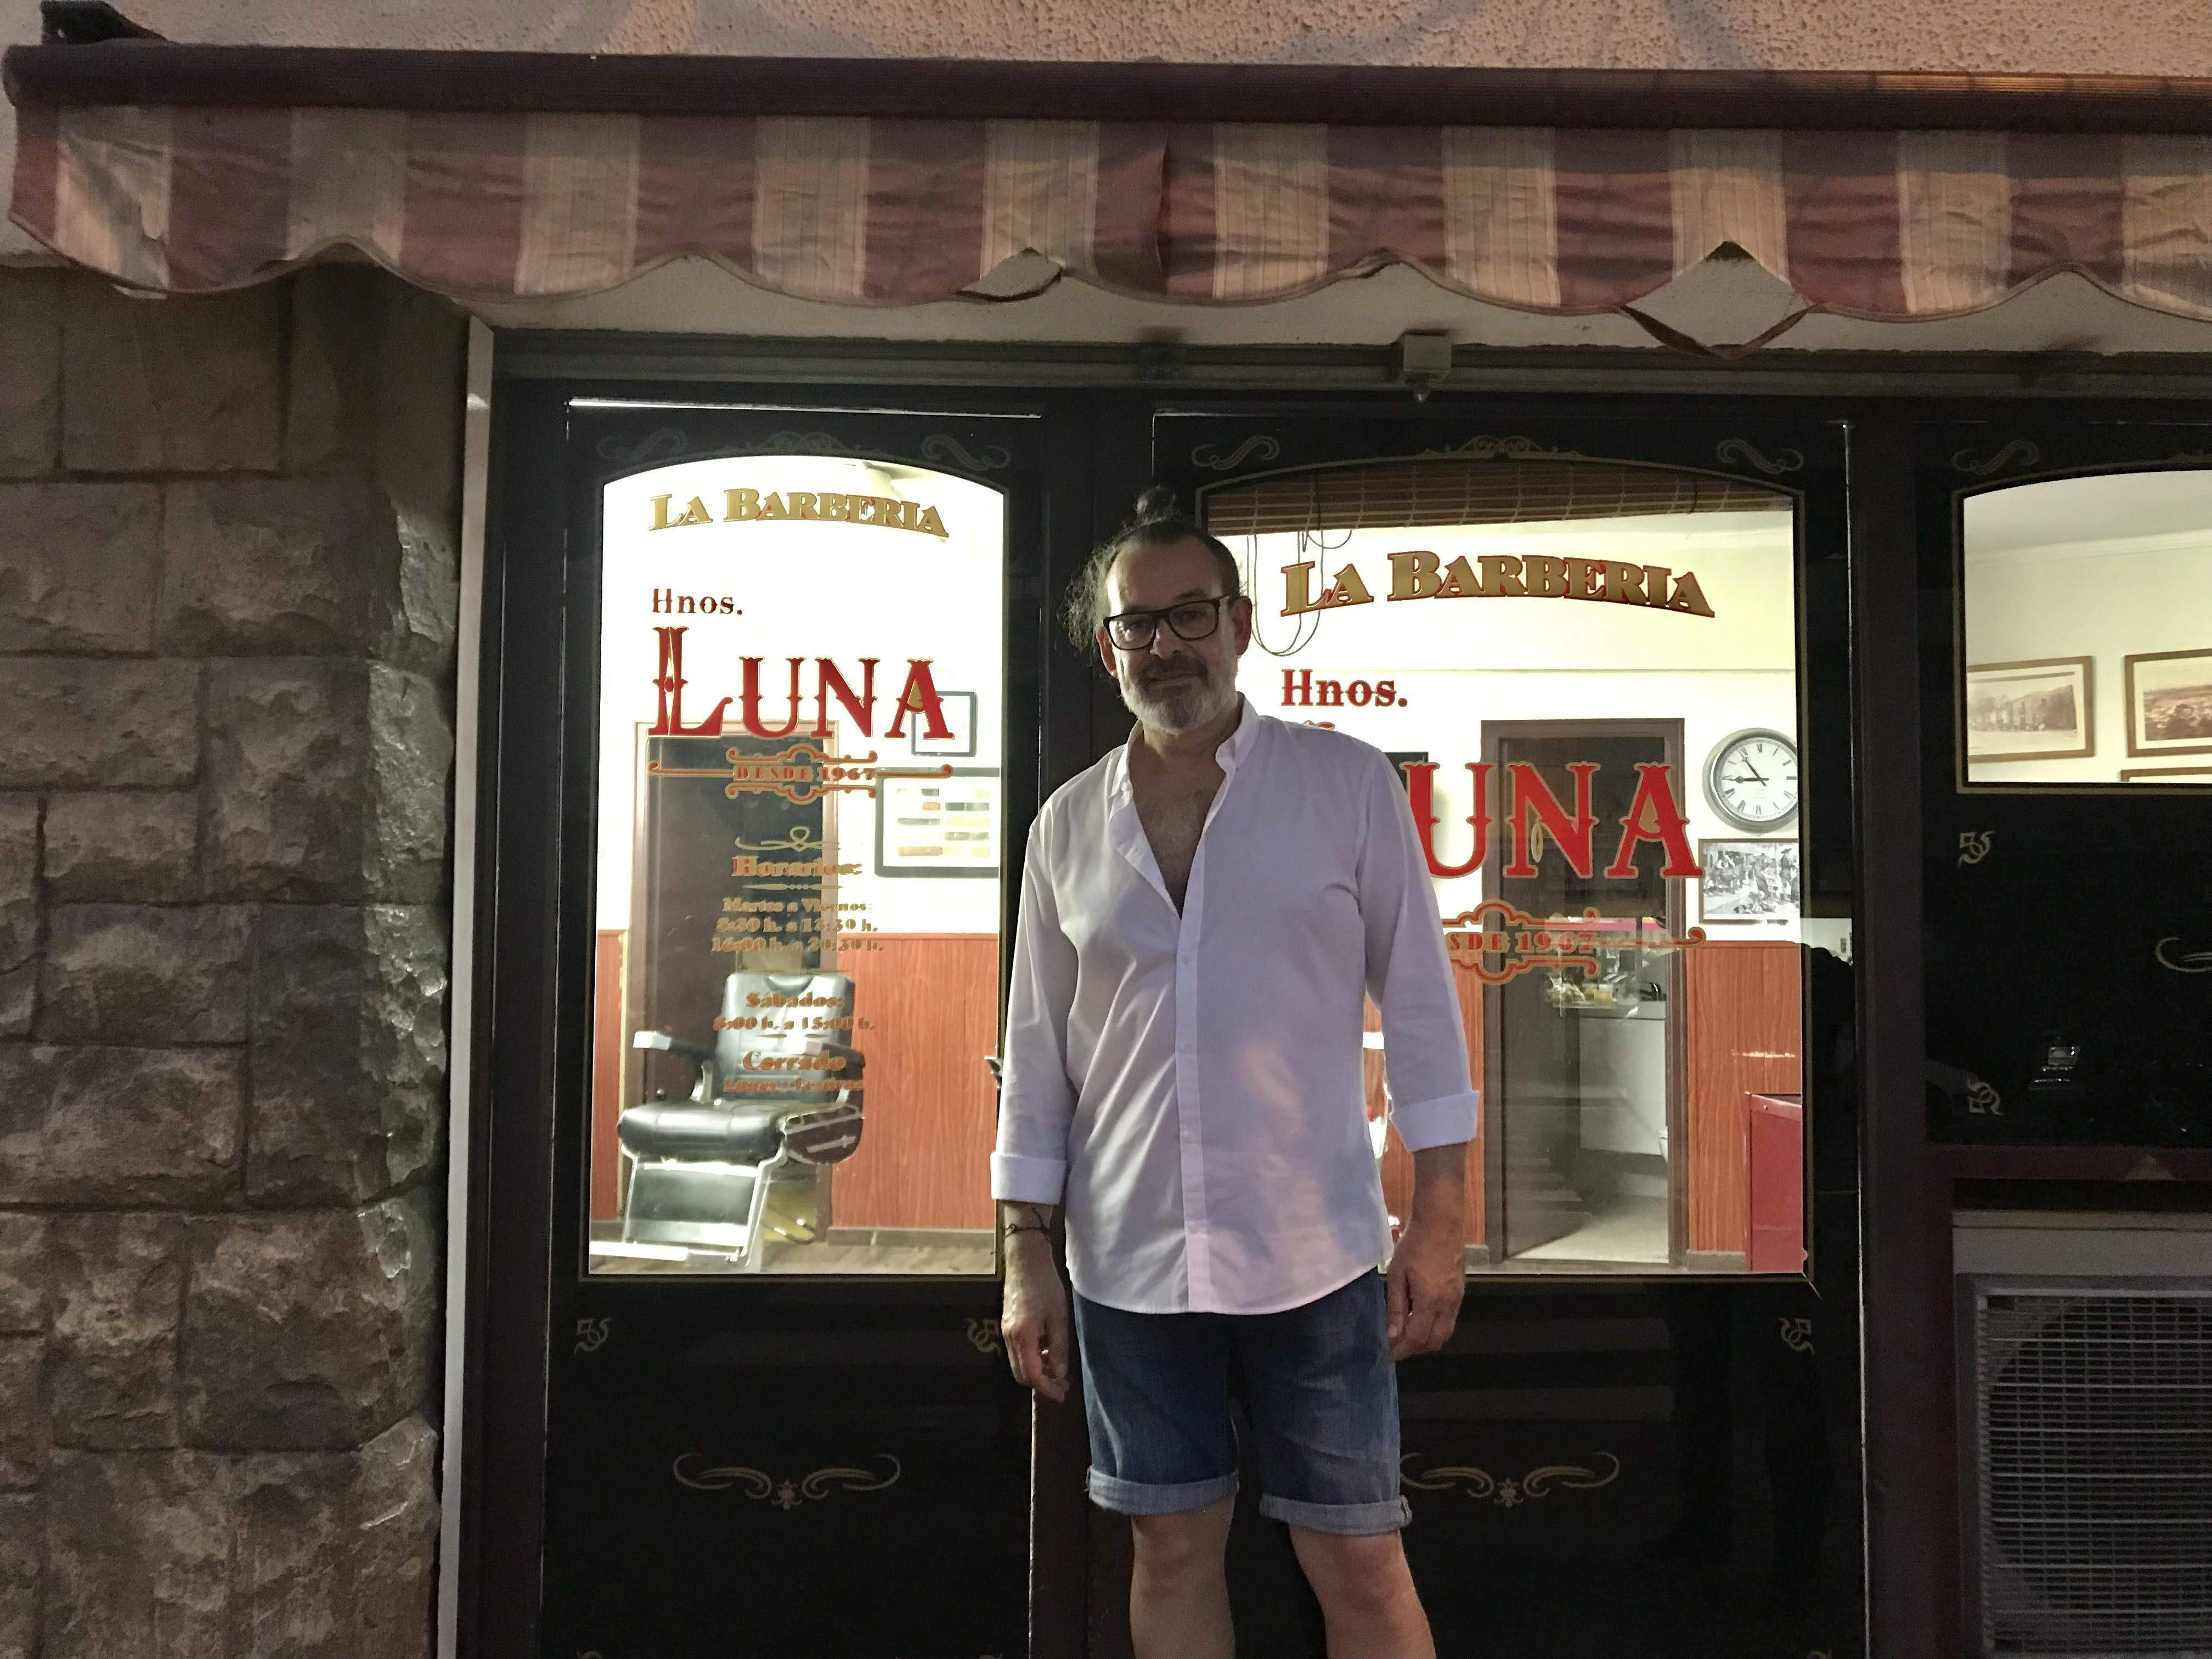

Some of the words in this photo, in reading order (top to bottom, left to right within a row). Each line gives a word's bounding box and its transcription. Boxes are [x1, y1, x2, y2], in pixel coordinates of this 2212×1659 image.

[650, 494, 713, 531] LA
[723, 488, 949, 538] BARBERIA
[651, 588, 743, 615] Hnos.
[1280, 561, 1374, 617] LA
[1387, 550, 1716, 618] BARBERIA
[647, 626, 955, 740] LUNA
[1281, 669, 1408, 708] Hnos.
[733, 765, 813, 782] DESDE
[817, 765, 874, 782] 1967
[1304, 720, 1704, 878] UNA
[1446, 932, 1510, 952] SDE
[1515, 932, 1594, 953] 1967
[742, 1051, 847, 1071] Cerrado
